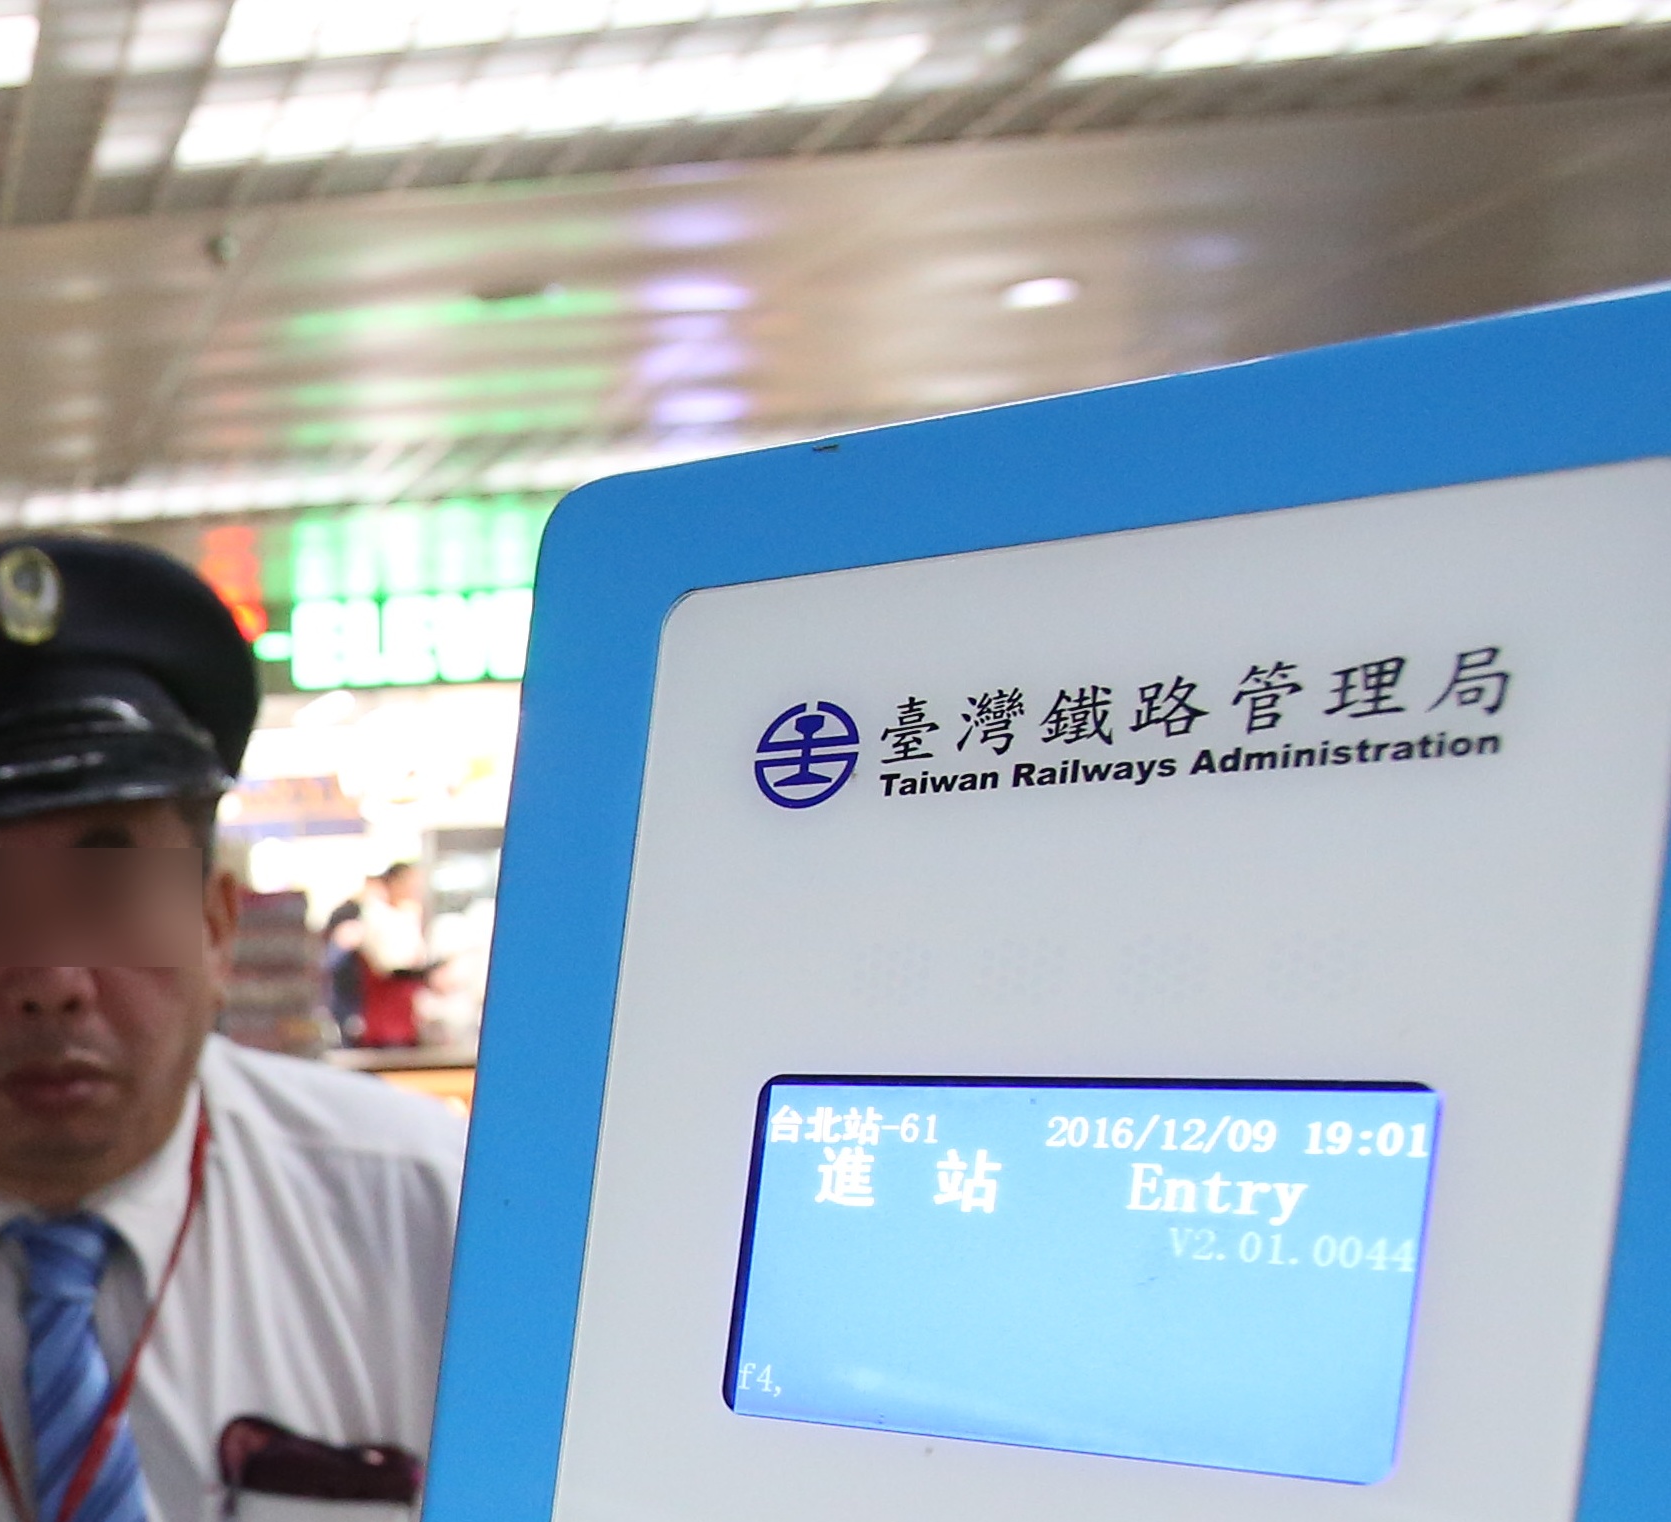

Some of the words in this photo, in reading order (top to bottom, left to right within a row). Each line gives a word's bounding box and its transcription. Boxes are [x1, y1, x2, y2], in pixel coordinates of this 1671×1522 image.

[880, 647, 1510, 764] 臺灣鐵路管理局
[880, 770, 999, 797] Taiwan
[1011, 756, 1178, 787] Railways
[1189, 732, 1501, 775] Administration
[769, 1104, 939, 1146] 台北站-61
[1045, 1114, 1278, 1154] 2016/12/09
[1303, 1120, 1429, 1159] 19:01
[1126, 1162, 1309, 1227] Entry
[1169, 1227, 1416, 1273] V2.01.0044
